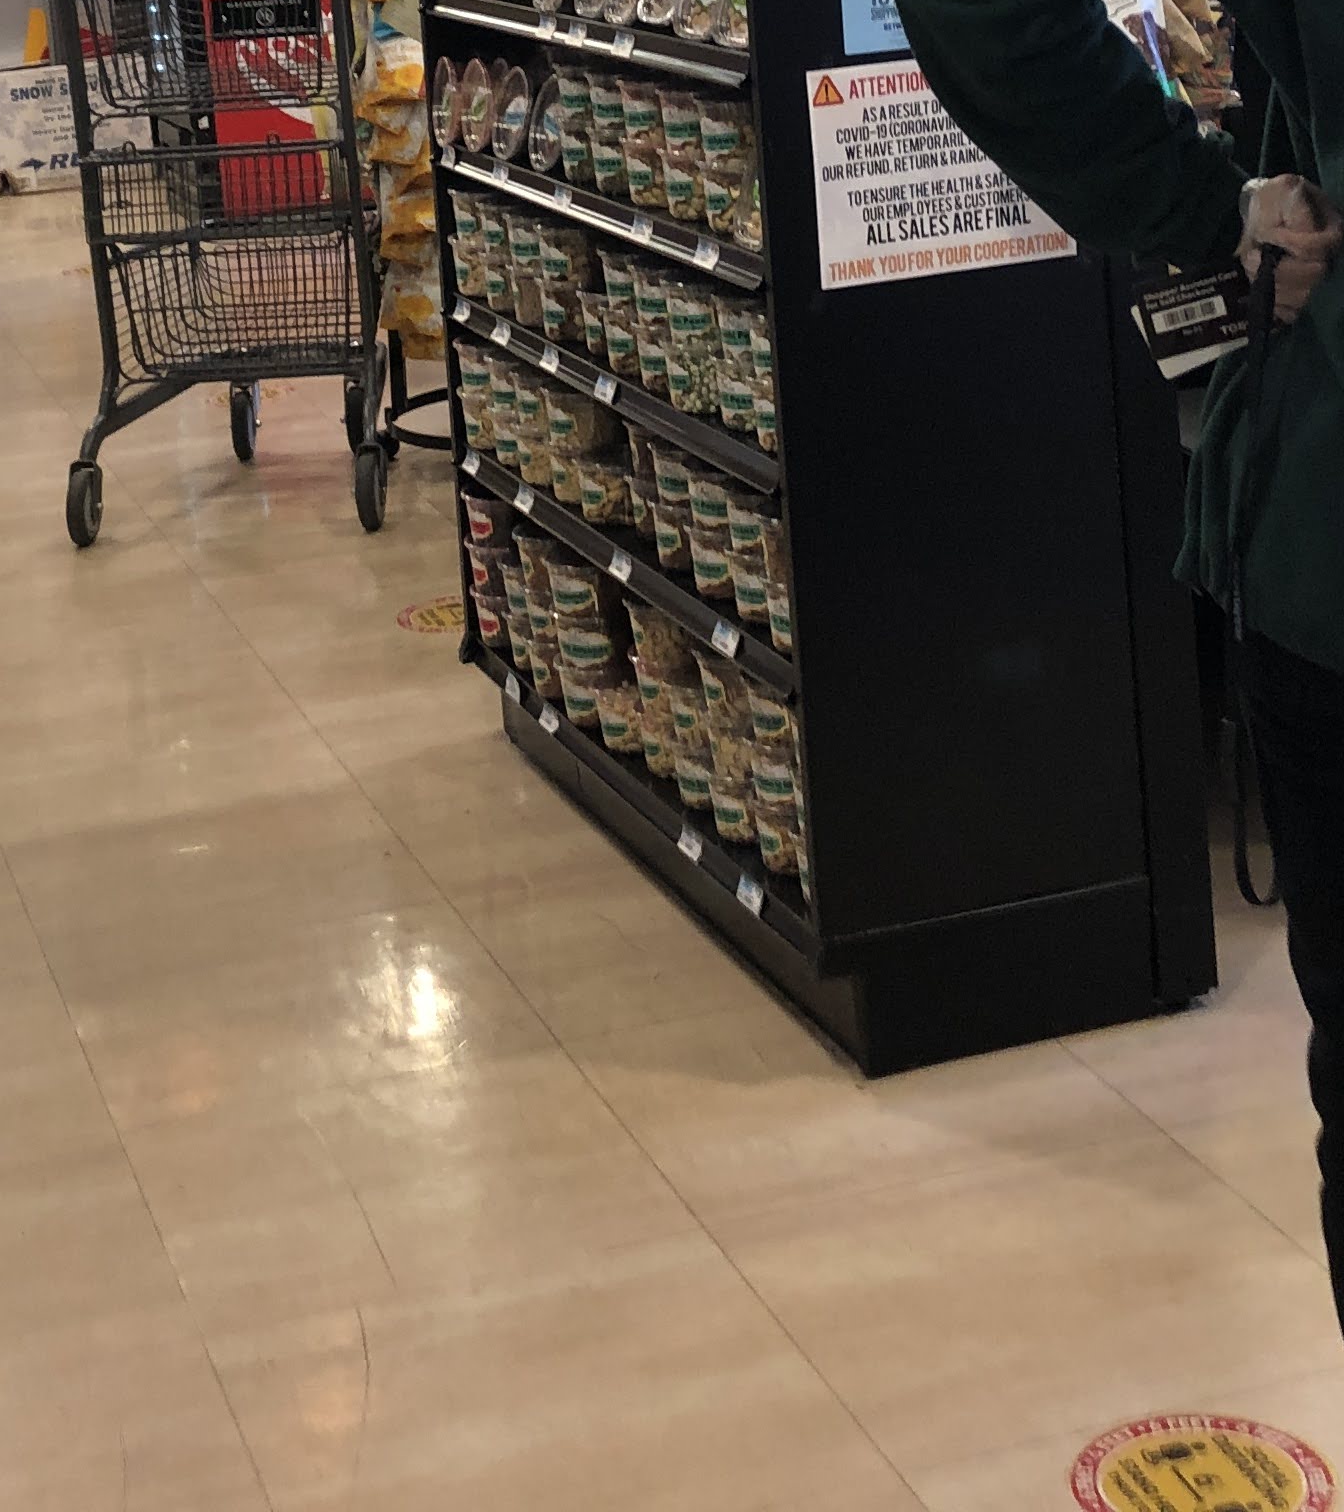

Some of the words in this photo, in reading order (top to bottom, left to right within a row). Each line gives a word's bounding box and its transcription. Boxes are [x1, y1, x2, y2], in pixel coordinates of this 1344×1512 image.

[9, 84, 54, 102] SNOW
[849, 71, 931, 100] ATTENTION
[862, 106, 878, 124] AS
[879, 105, 888, 121] A
[888, 100, 930, 120] RESULT
[836, 123, 888, 145] COVID-19
[889, 116, 956, 138] (CORONAVI
[822, 164, 844, 182] OUR
[846, 158, 893, 180] REFUND,
[894, 152, 939, 173] RETURN
[939, 149, 949, 167] &
[949, 147, 987, 165] RAINC
[845, 144, 863, 161] WE
[864, 140, 894, 158] HAVE
[847, 190, 862, 209] TO
[863, 183, 908, 206] ENSURE
[908, 181, 930, 199] THE
[931, 175, 973, 196] HEALTH
[974, 173, 984, 189] &
[984, 171, 1014, 189] SAF
[862, 205, 885, 223] OUR
[886, 196, 953, 221] EMPLOYEES
[954, 194, 963, 211] &
[866, 222, 896, 246] ALL
[898, 213, 950, 242] SALES
[953, 208, 984, 235] ARE
[985, 202, 1032, 230] FINAL
[828, 256, 877, 282] THANK
[878, 252, 907, 276] YOU
[907, 249, 934, 272] FOR
[936, 243, 972, 267] YOUR
[974, 231, 1069, 262] COOPERATION!
